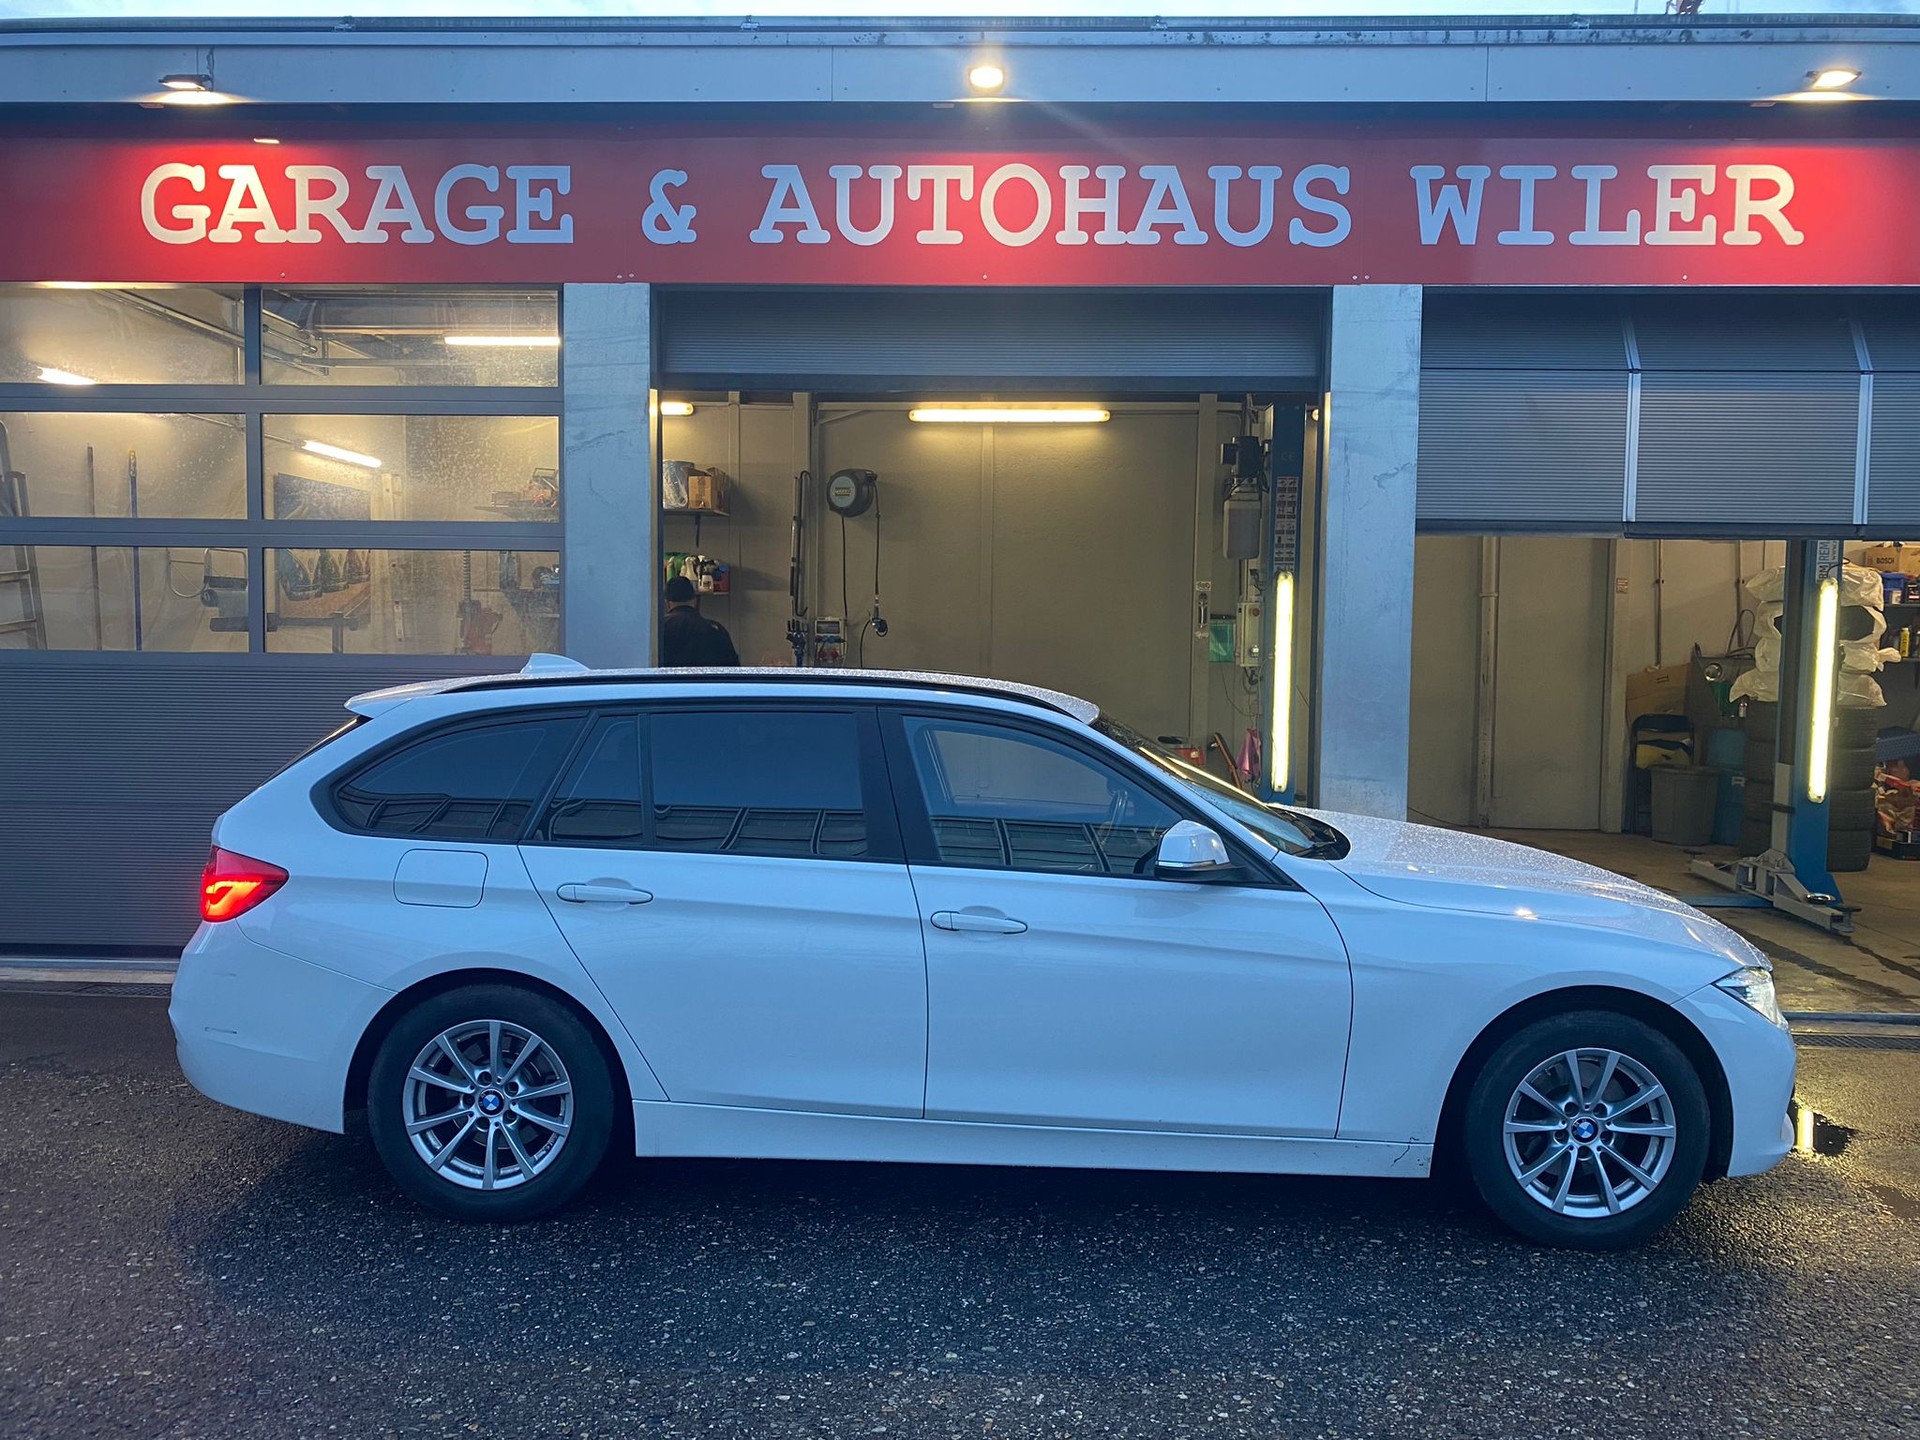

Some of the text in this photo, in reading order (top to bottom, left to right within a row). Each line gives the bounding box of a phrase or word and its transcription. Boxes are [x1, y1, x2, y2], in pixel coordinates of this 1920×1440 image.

[141, 163, 1804, 247] GARAGE & AUTOHAUS WILER
